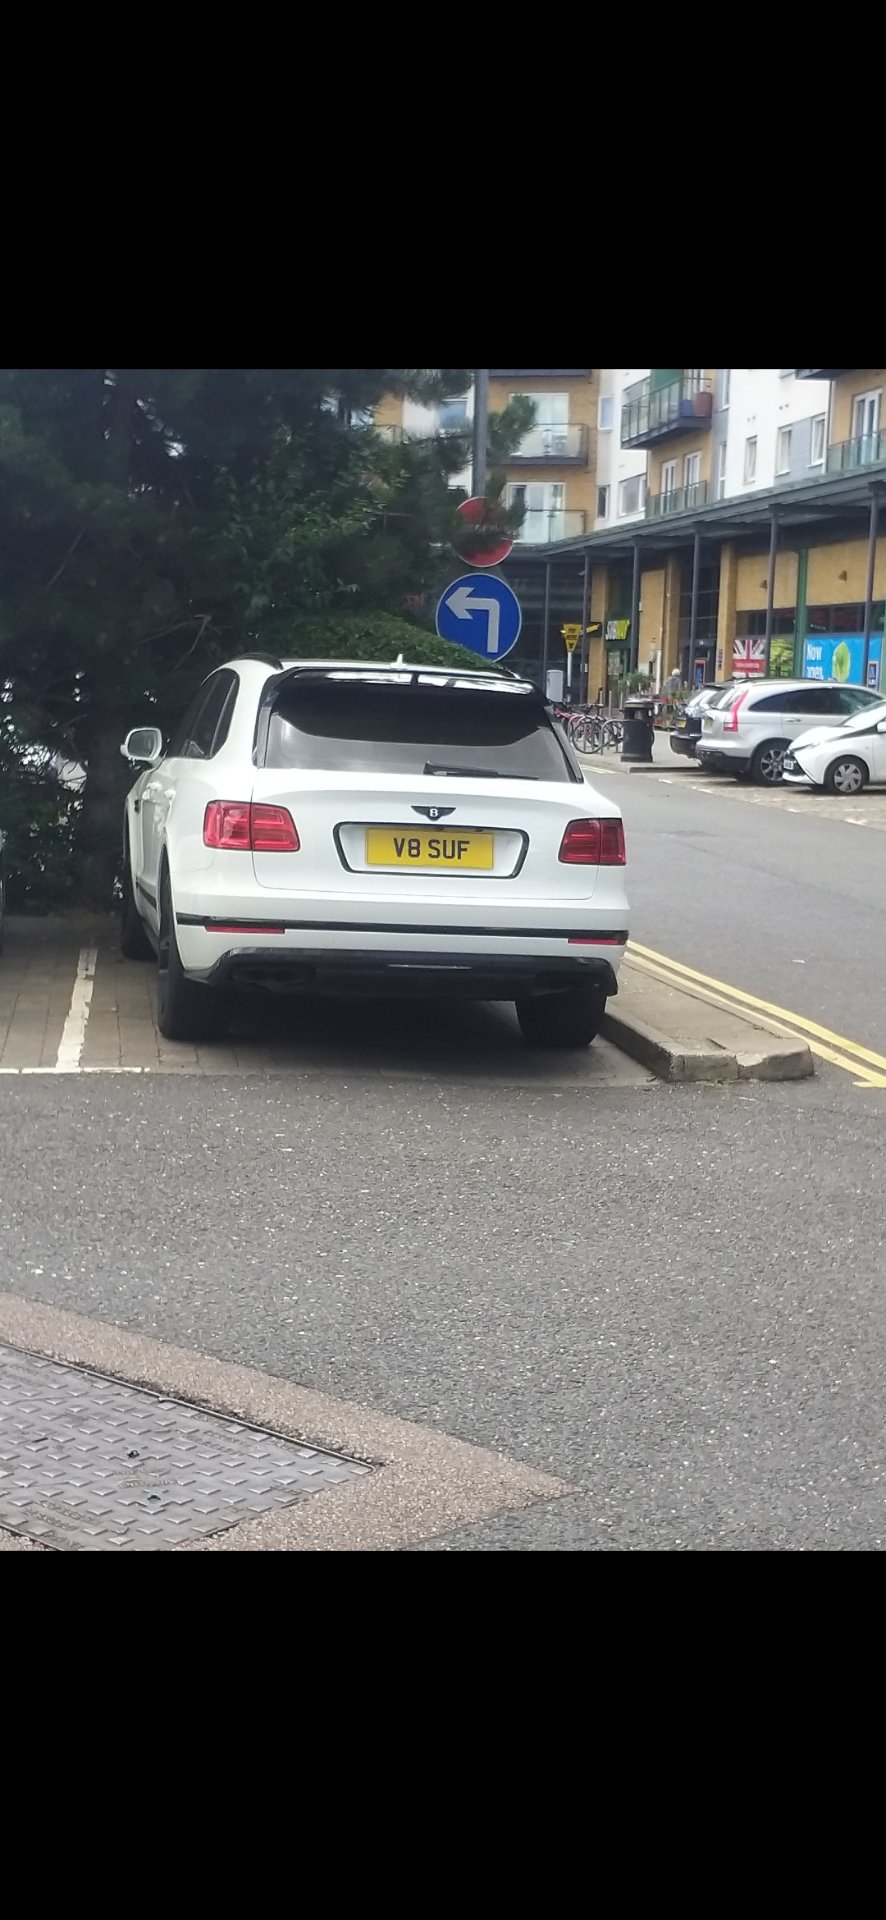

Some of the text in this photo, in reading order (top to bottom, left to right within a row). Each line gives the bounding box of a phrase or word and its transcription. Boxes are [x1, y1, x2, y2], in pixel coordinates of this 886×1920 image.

[806, 643, 823, 661] Now
[429, 808, 439, 818] B
[393, 837, 471, 860] V8 SUF
